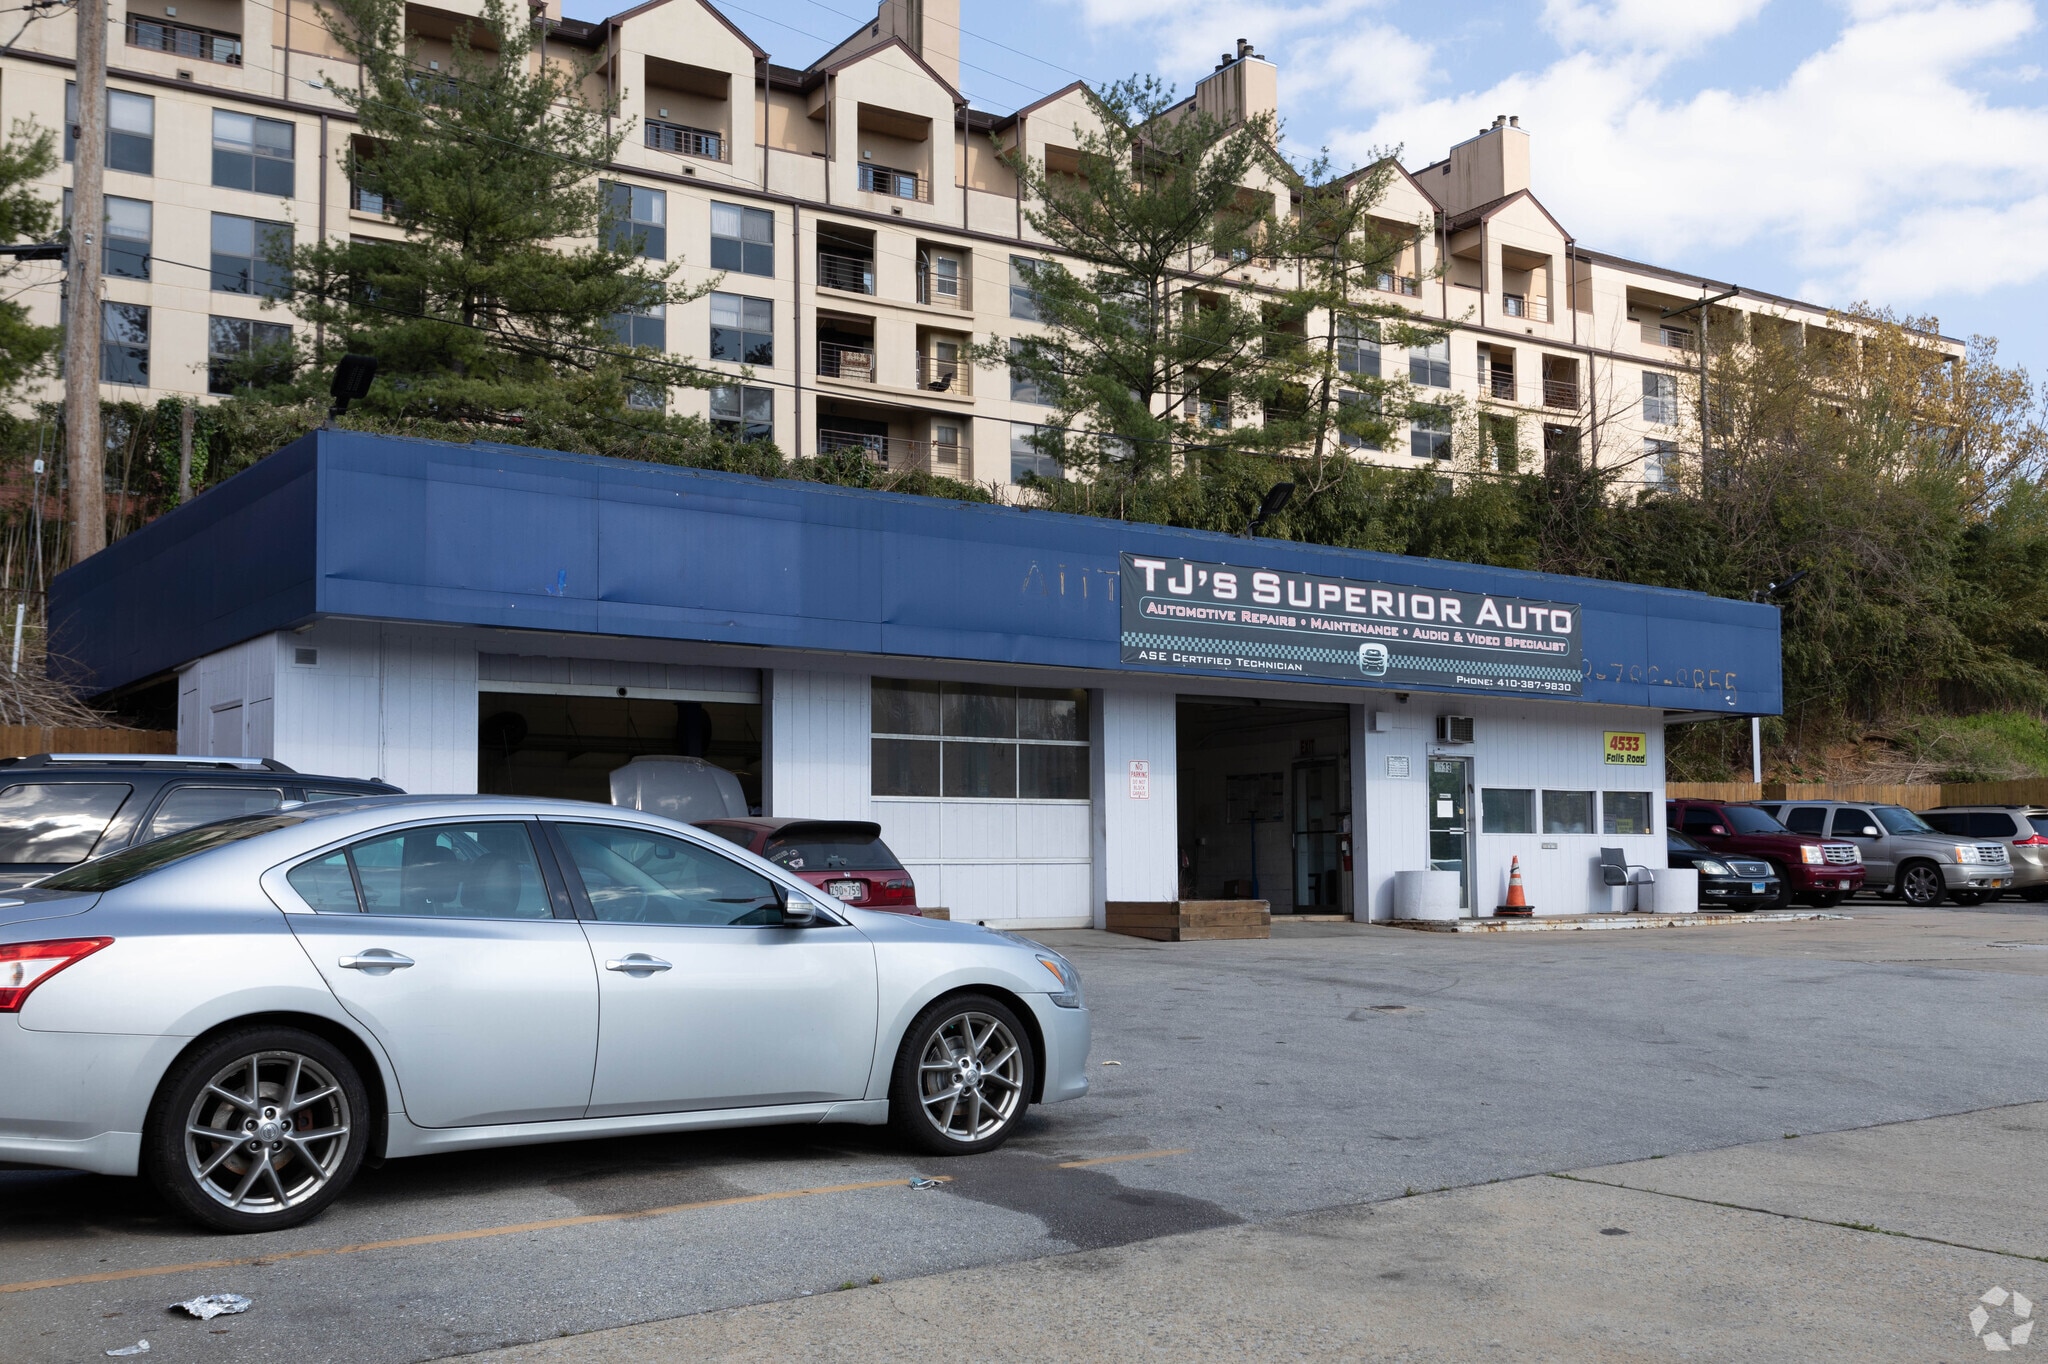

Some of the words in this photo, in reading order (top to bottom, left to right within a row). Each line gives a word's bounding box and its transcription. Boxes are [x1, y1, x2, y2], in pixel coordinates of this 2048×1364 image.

[1252, 571, 1464, 624] SUPERIOR
[1475, 598, 1572, 634] AUTO
[1146, 601, 1236, 622] AUTOMOTIVE
[1241, 610, 1297, 628] REPAIRS
[1310, 617, 1399, 637] MAINTENANCE
[1413, 627, 1449, 642] AUDIO
[1453, 632, 1463, 643] &
[1466, 632, 1500, 646] VIDEO
[1504, 636, 1566, 652] SPECIALIST
[1139, 651, 1167, 661] ASE
[1172, 653, 1232, 666] CERTIFIED
[1236, 658, 1302, 671] TECHNICIAN
[1456, 675, 1494, 686] PHONE:
[1497, 678, 1572, 692] 410-387-9830
[1300, 739, 1315, 754] EXIT
[1609, 735, 1640, 752] 4533
[1606, 753, 1624, 763] Falls
[1626, 753, 1645, 763] Road
[1135, 763, 1143, 771] NO
